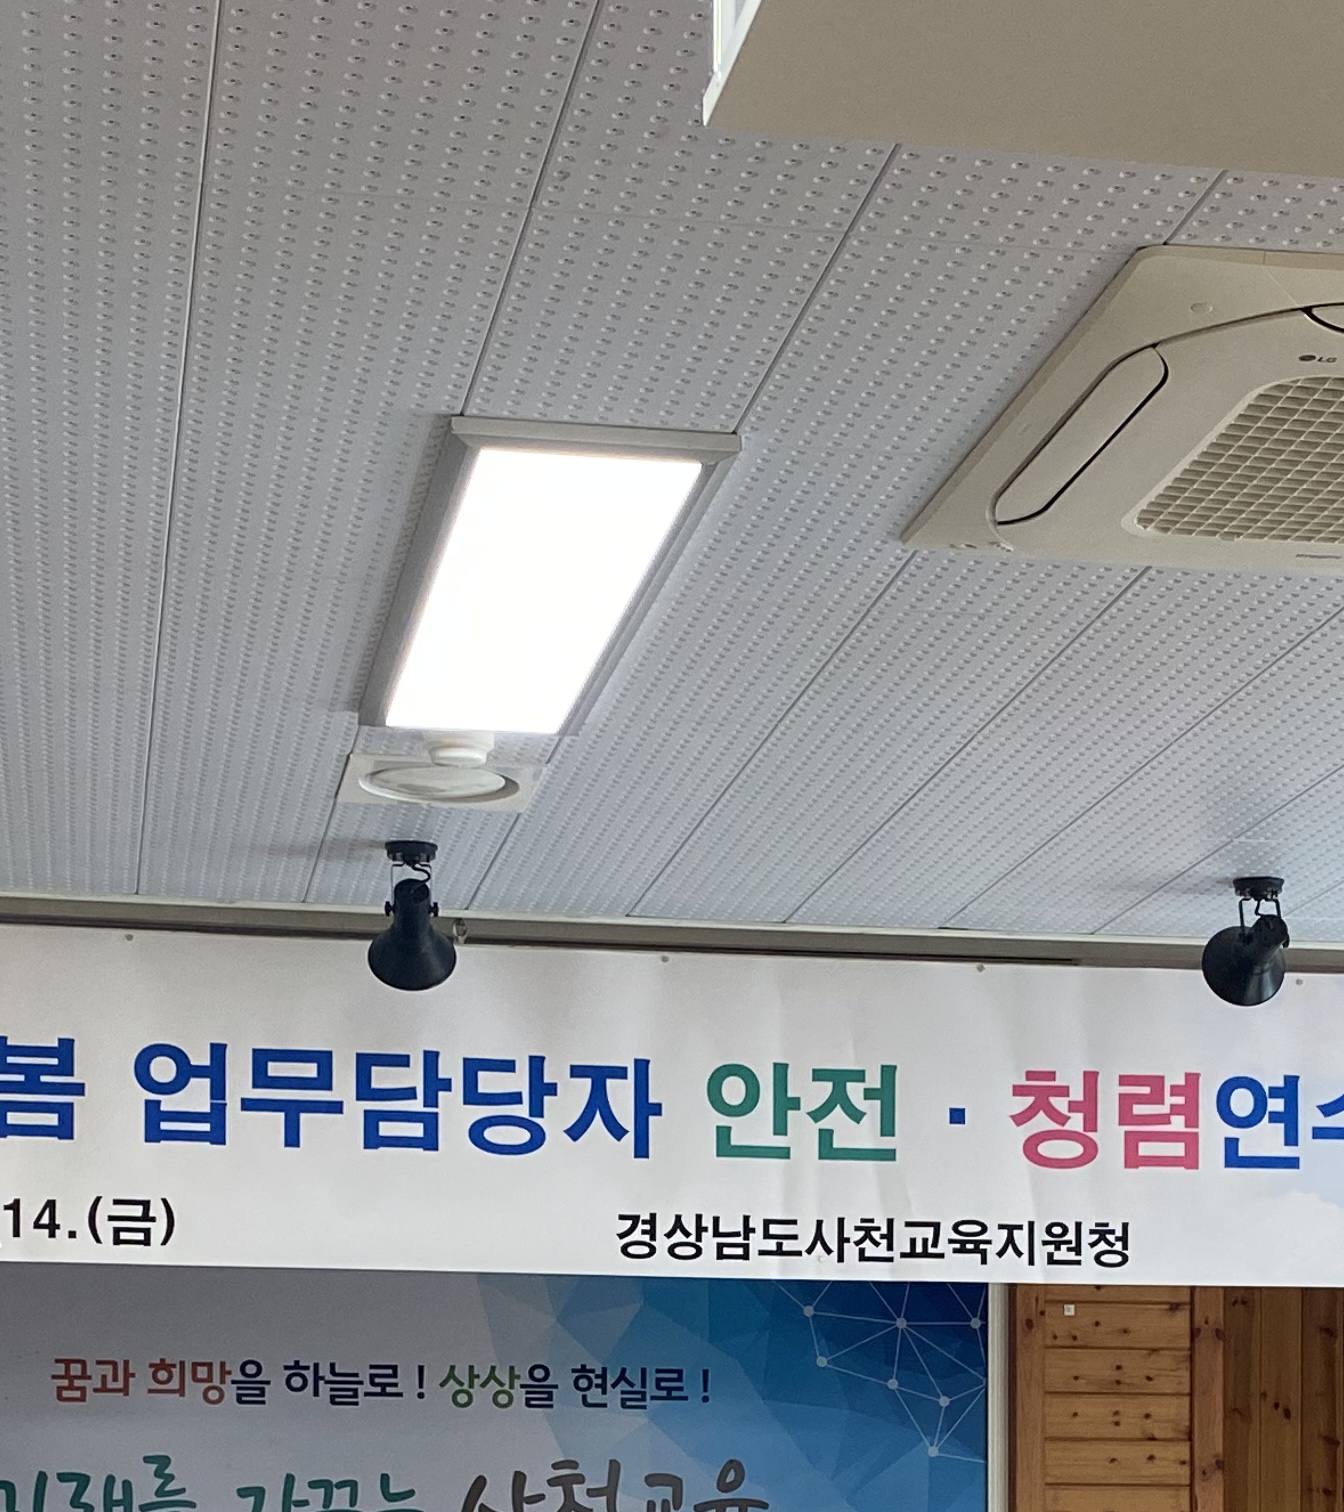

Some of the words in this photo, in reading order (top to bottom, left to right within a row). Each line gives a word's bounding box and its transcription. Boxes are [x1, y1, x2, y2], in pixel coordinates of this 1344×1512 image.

[134, 1042, 662, 1159] 업무담당자
[707, 1062, 897, 1162] 안전
[2, 1196, 176, 1247] 14.(금)
[616, 1213, 1129, 1268] 경상남도사천교육지원청
[51, 1358, 136, 1402] 꿈과
[147, 1358, 271, 1405] 희망을
[439, 1362, 559, 1410] 상상을
